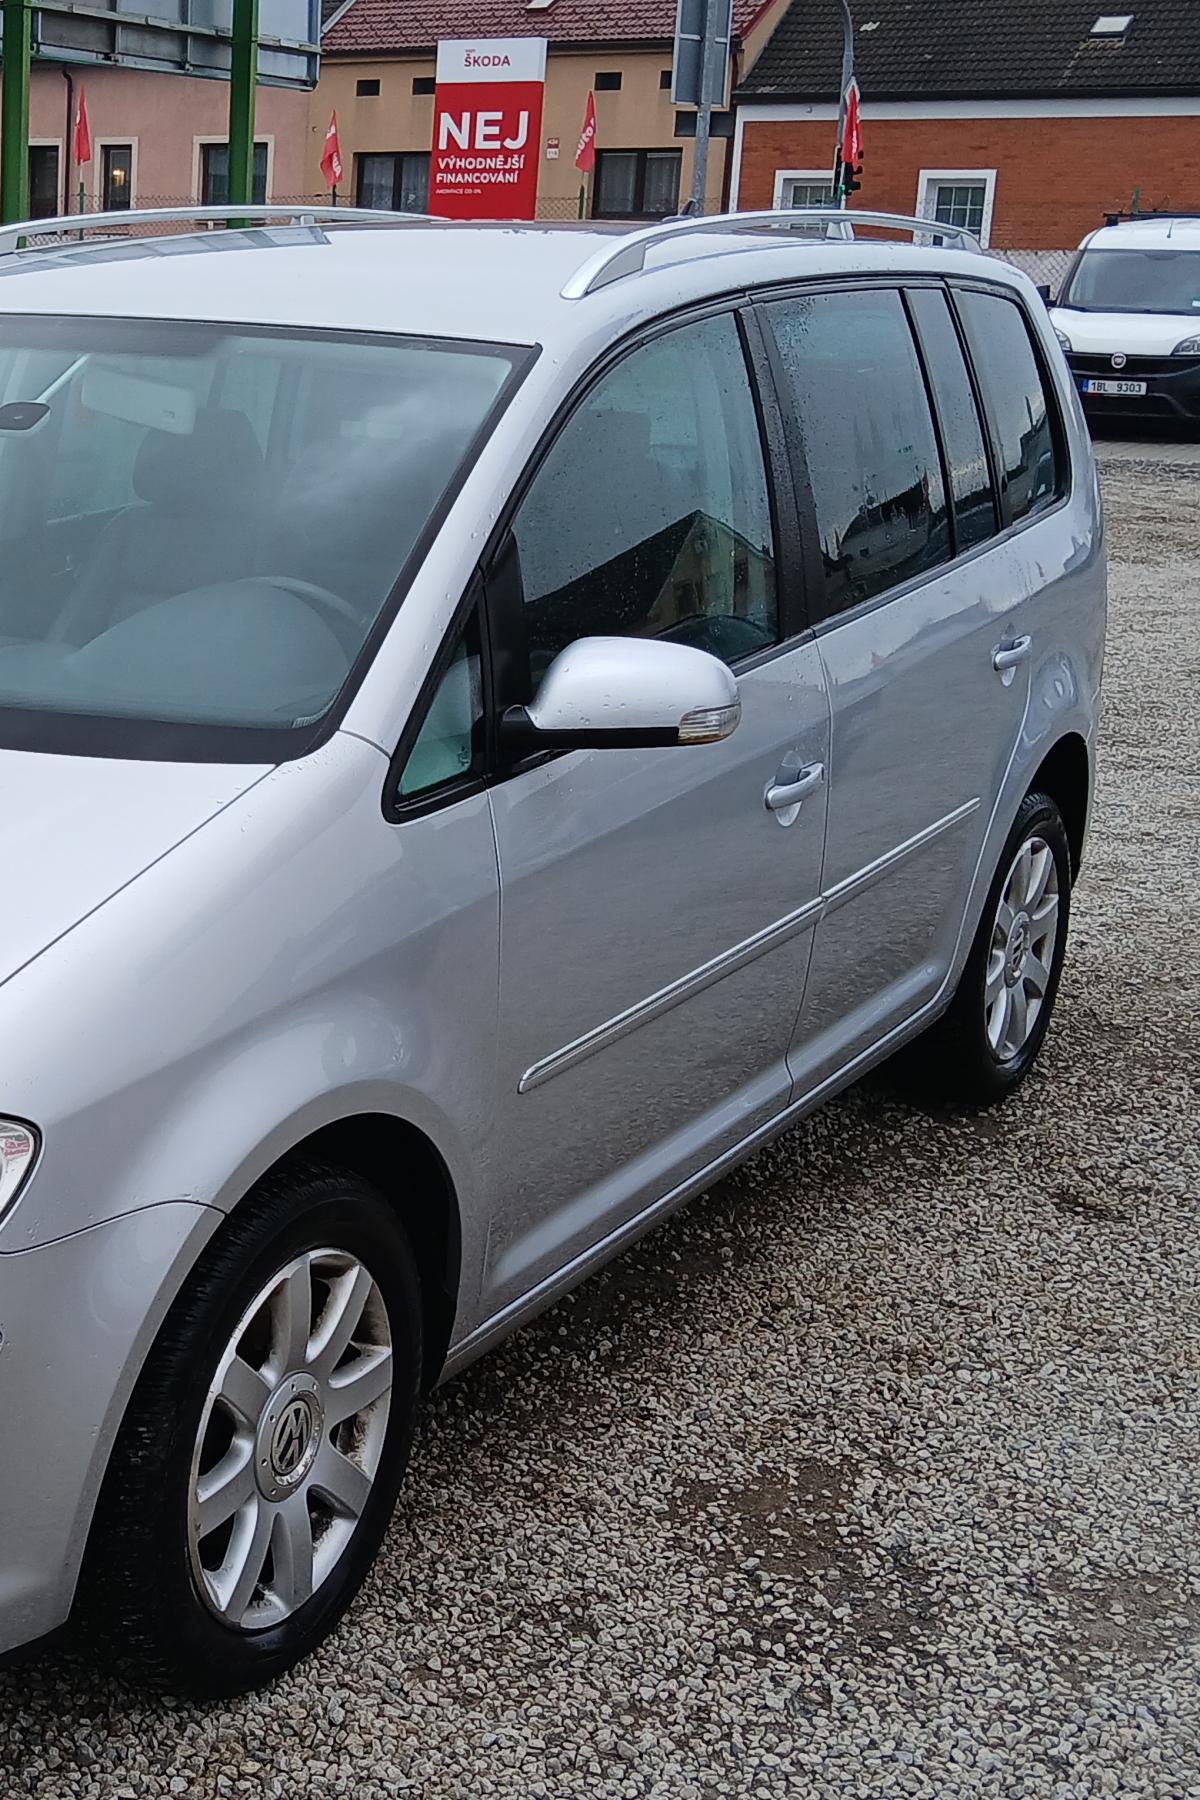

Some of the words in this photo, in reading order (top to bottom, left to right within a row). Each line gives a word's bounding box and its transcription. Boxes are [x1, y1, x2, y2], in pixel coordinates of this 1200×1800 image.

[464, 53, 511, 68] ŠKODA
[438, 110, 529, 150] NEJ
[438, 153, 525, 170] VÝHODNĚJŠÍ
[435, 170, 519, 184] FINANCOVÁNÍ
[1091, 381, 1108, 392] 1BL
[1116, 382, 1142, 393] 9303
